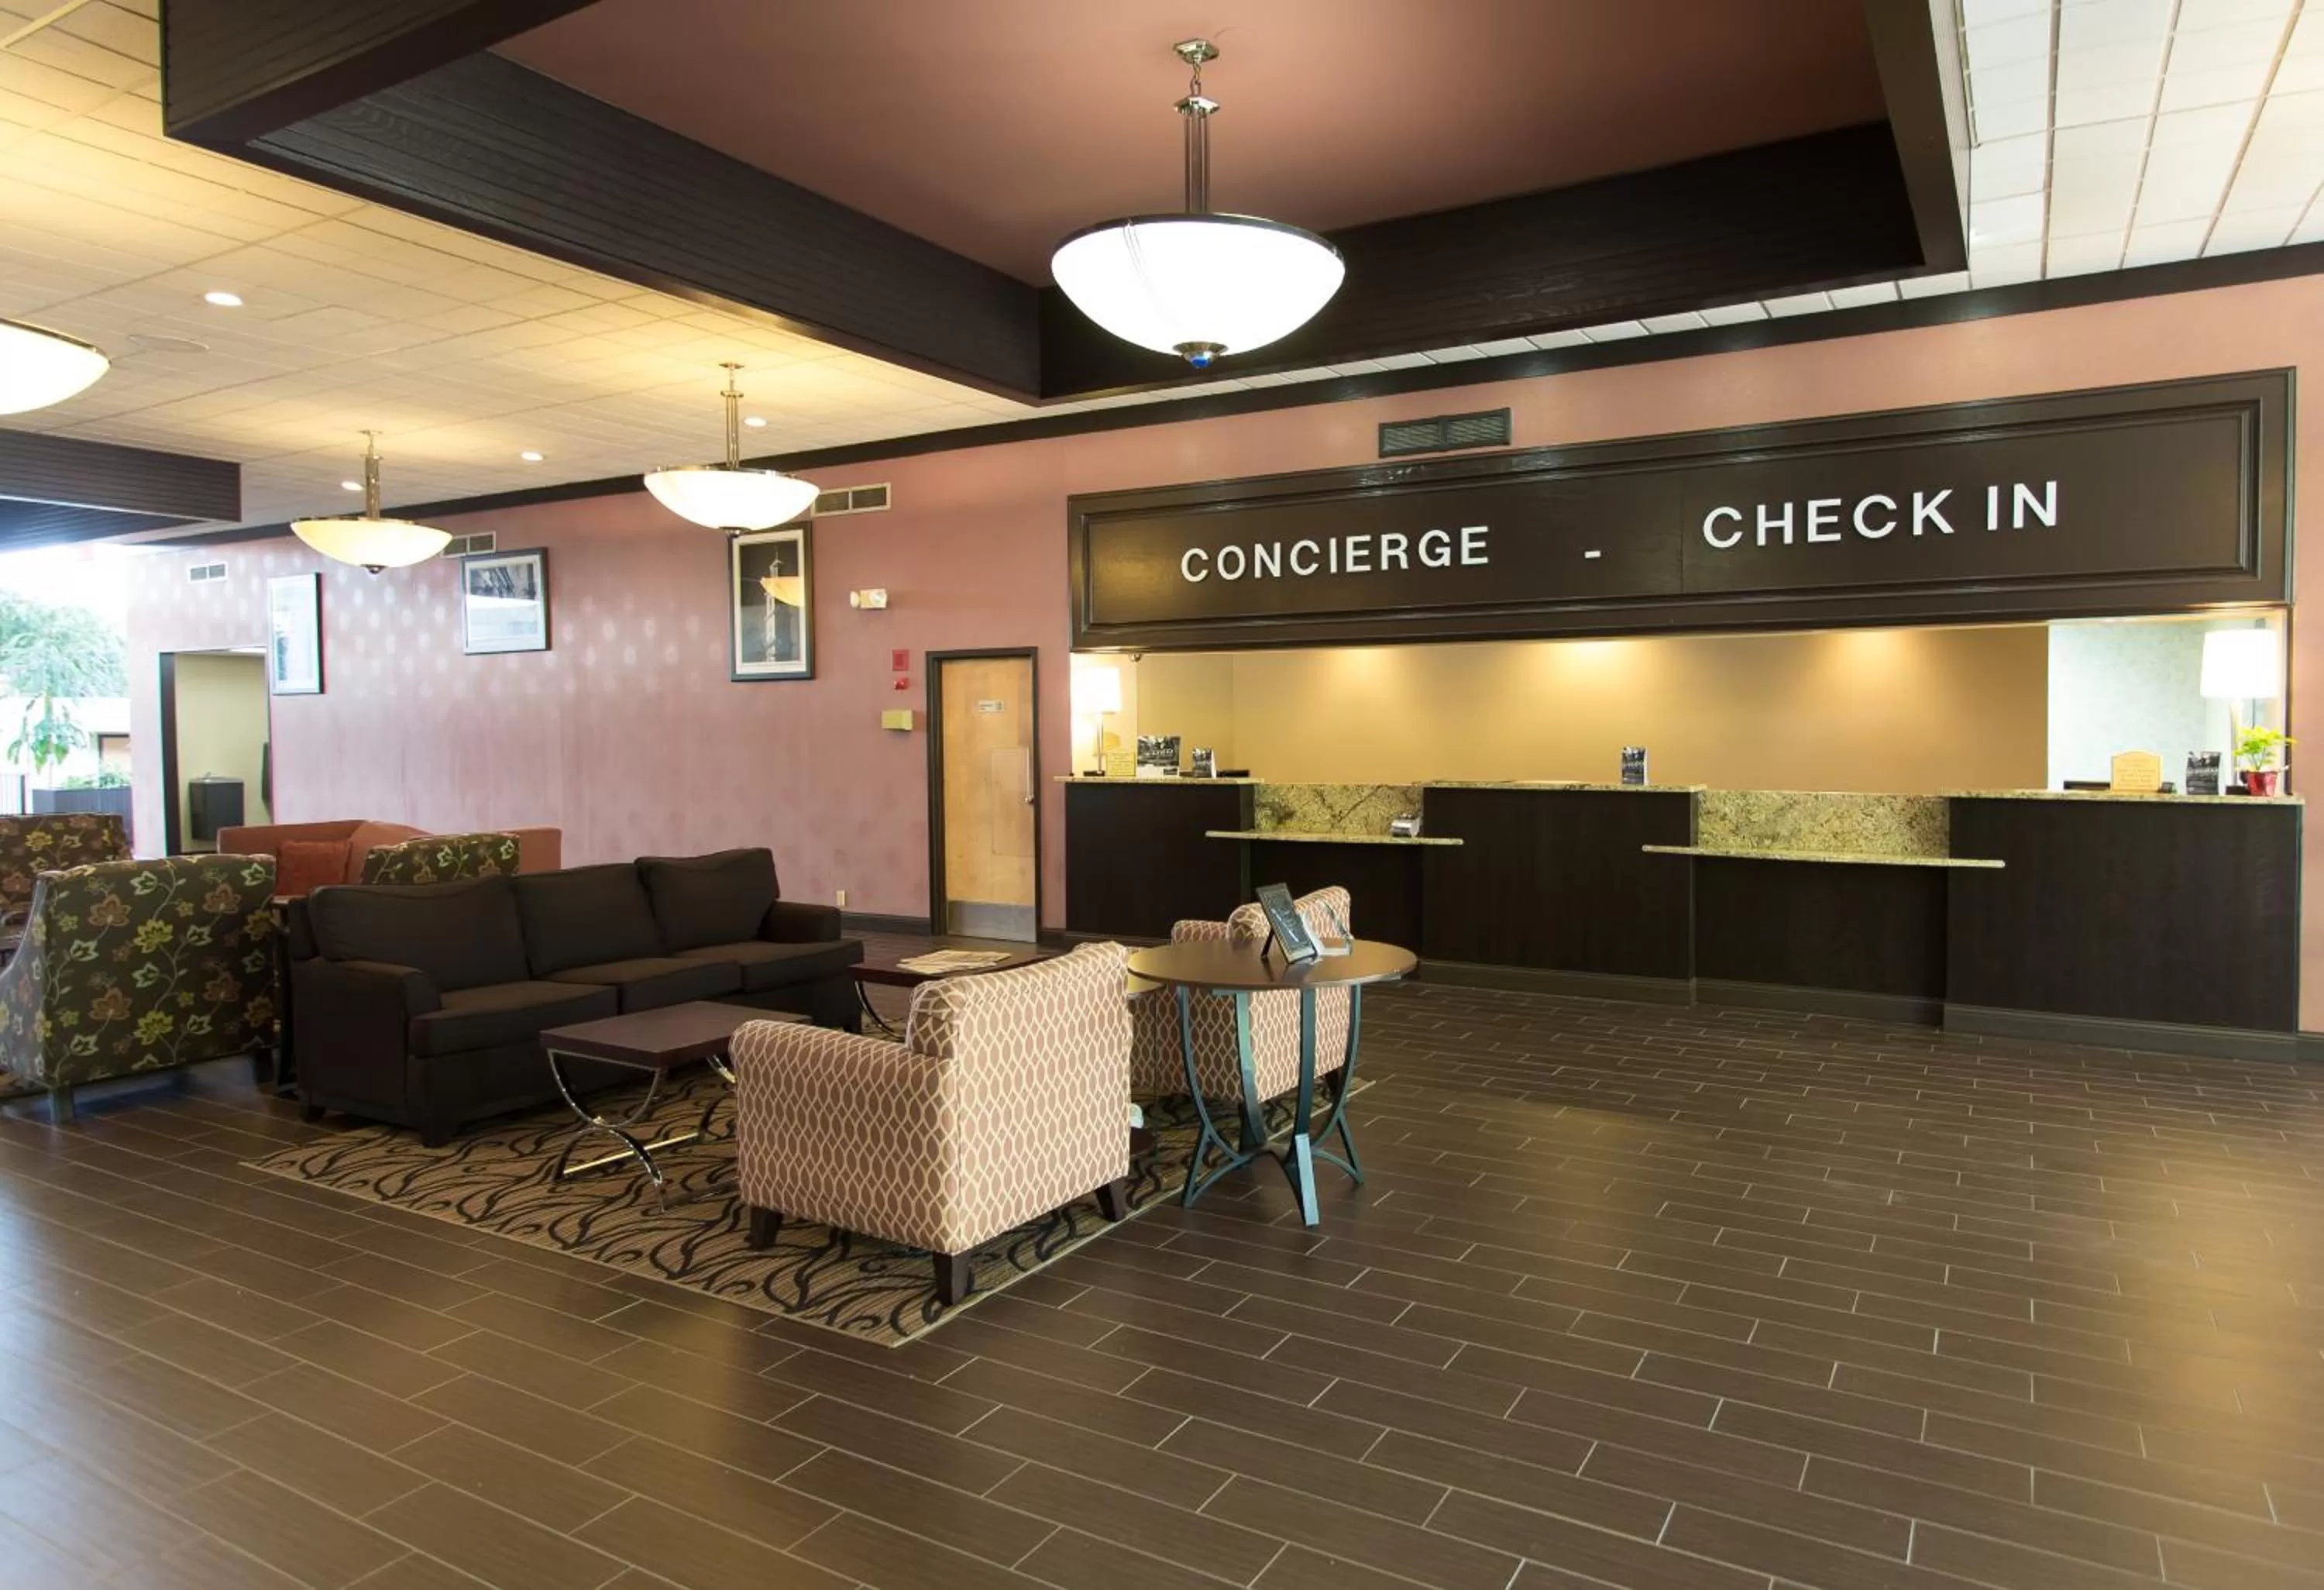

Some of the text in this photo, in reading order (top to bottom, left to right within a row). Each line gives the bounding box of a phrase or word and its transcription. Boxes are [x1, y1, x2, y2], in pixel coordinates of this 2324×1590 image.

[1181, 525, 1489, 583] CONCIERGE
[1703, 489, 1954, 549] CHECK
[1987, 480, 2058, 531] IN
